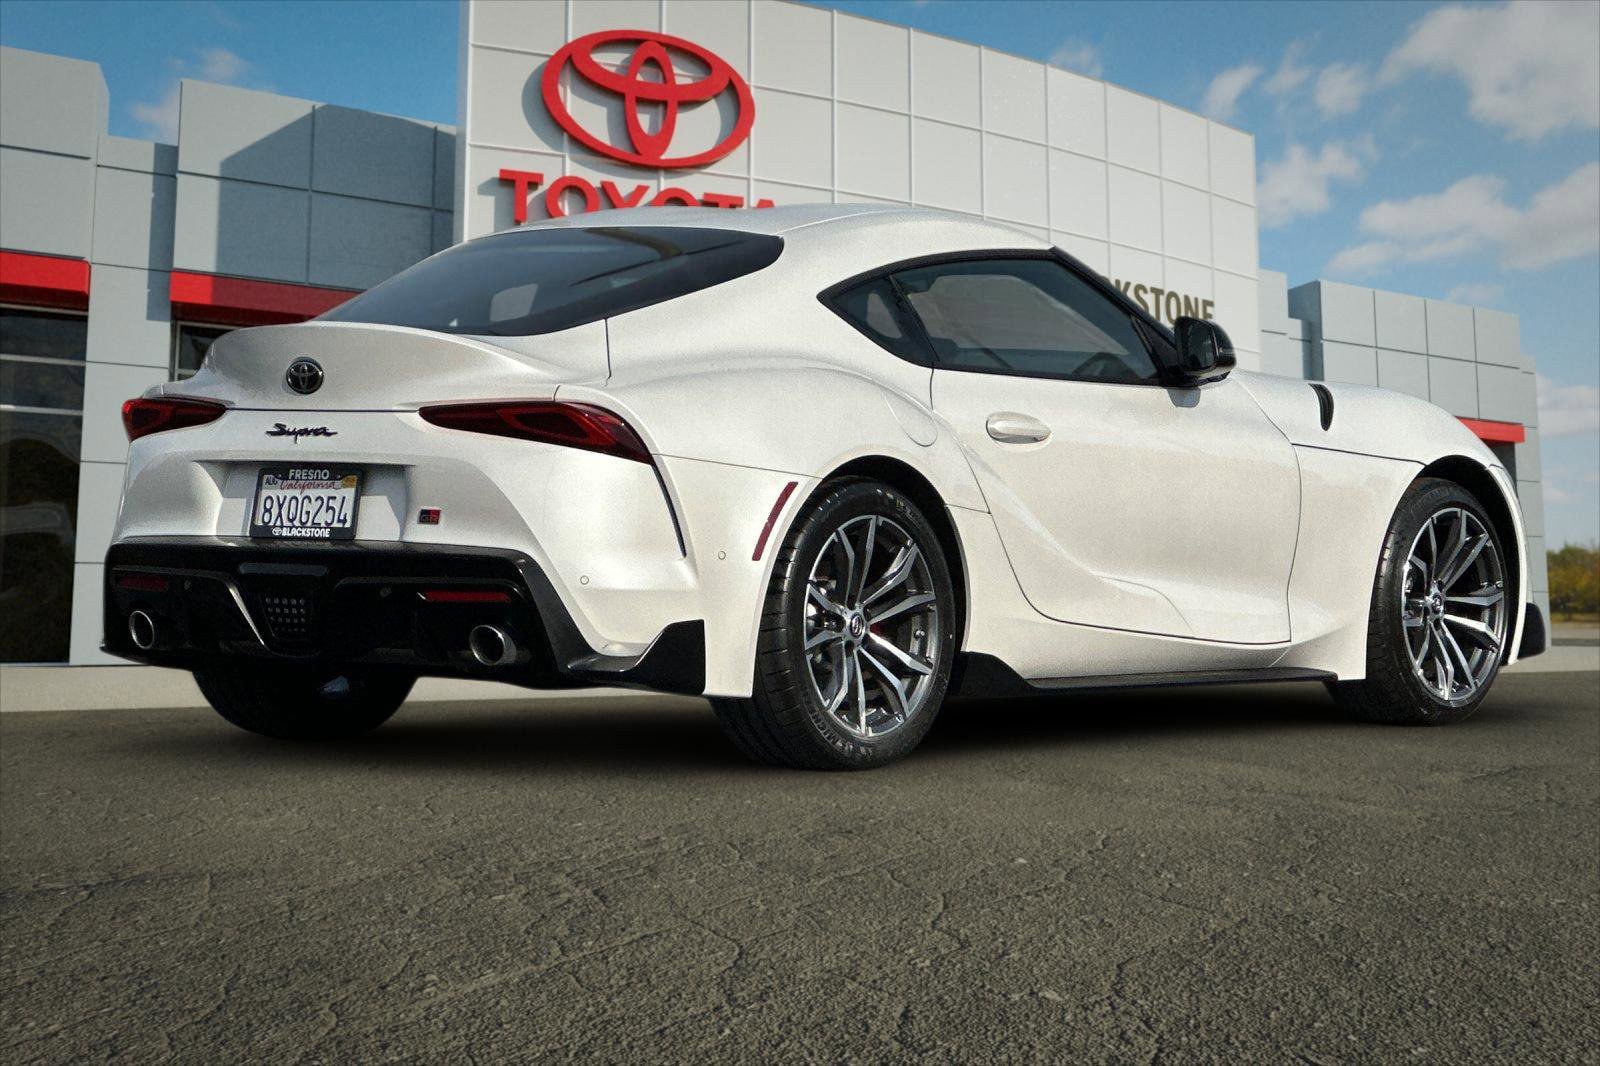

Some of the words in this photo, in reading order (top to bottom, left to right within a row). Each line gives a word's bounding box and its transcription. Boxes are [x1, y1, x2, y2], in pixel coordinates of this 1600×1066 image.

[265, 422, 338, 444] Supra
[288, 468, 330, 480] FRESNO
[262, 494, 348, 527] 8XQG254
[281, 527, 331, 538] BLACKSTONE
